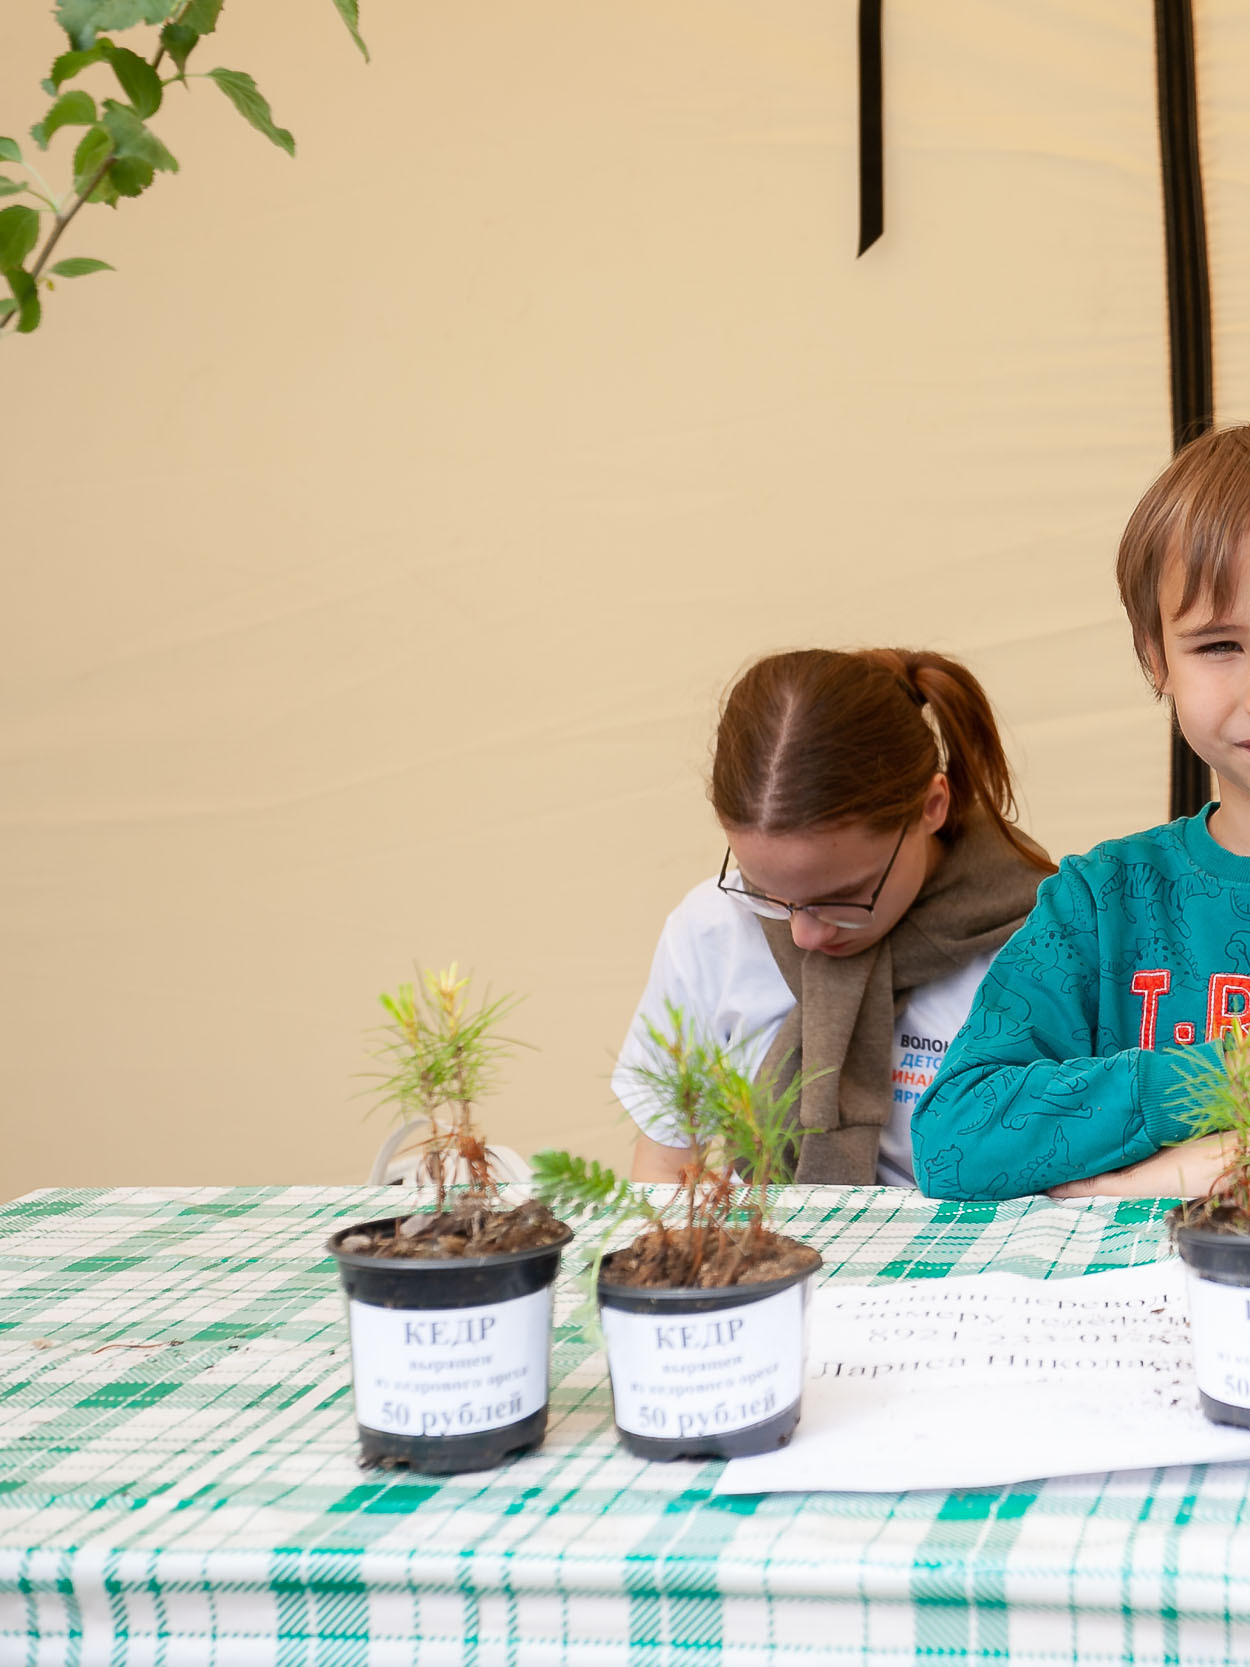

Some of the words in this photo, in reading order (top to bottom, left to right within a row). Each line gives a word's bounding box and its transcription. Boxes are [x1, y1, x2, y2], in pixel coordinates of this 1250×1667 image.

[404, 1316, 496, 1347] КЕДР
[655, 1318, 744, 1350] КЕДР
[1224, 1373, 1250, 1398] 50
[381, 1400, 410, 1426] 50
[421, 1392, 523, 1436] рублей
[638, 1405, 667, 1429] 50
[678, 1388, 776, 1436] рублей
